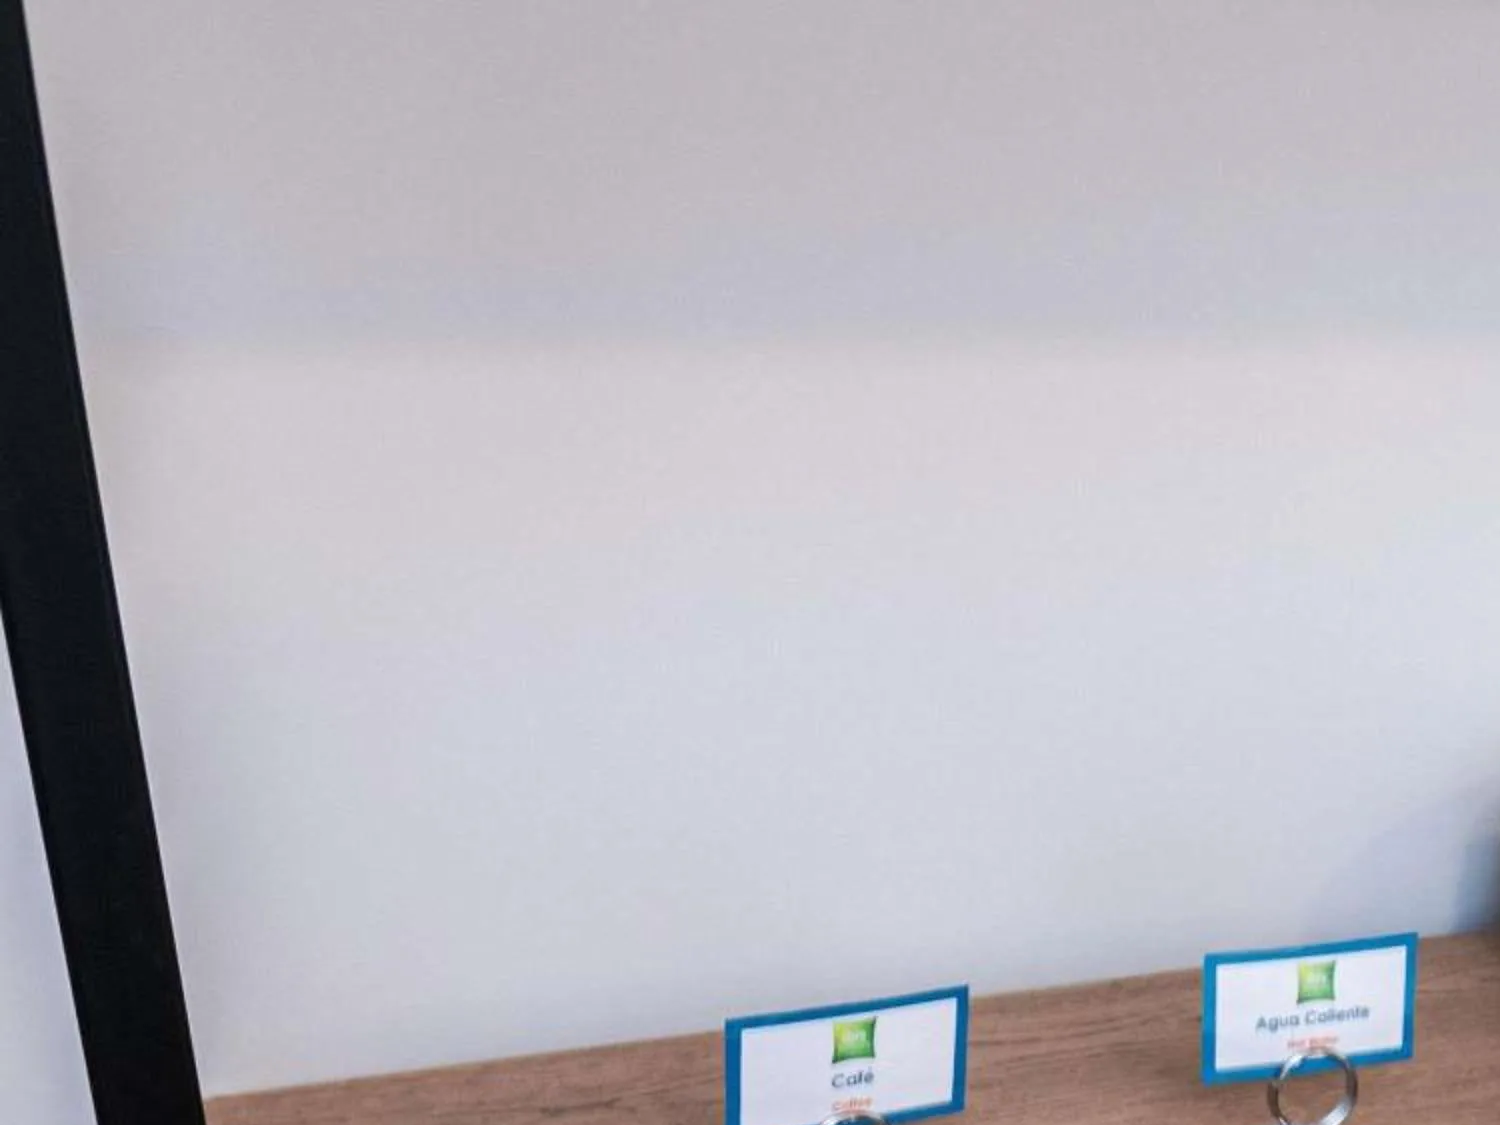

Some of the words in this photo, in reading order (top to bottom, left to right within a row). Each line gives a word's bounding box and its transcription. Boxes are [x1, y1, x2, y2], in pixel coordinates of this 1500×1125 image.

[1255, 1012, 1300, 1032] Agua
[1306, 1005, 1369, 1024] Caliente
[831, 1066, 875, 1089] Café
